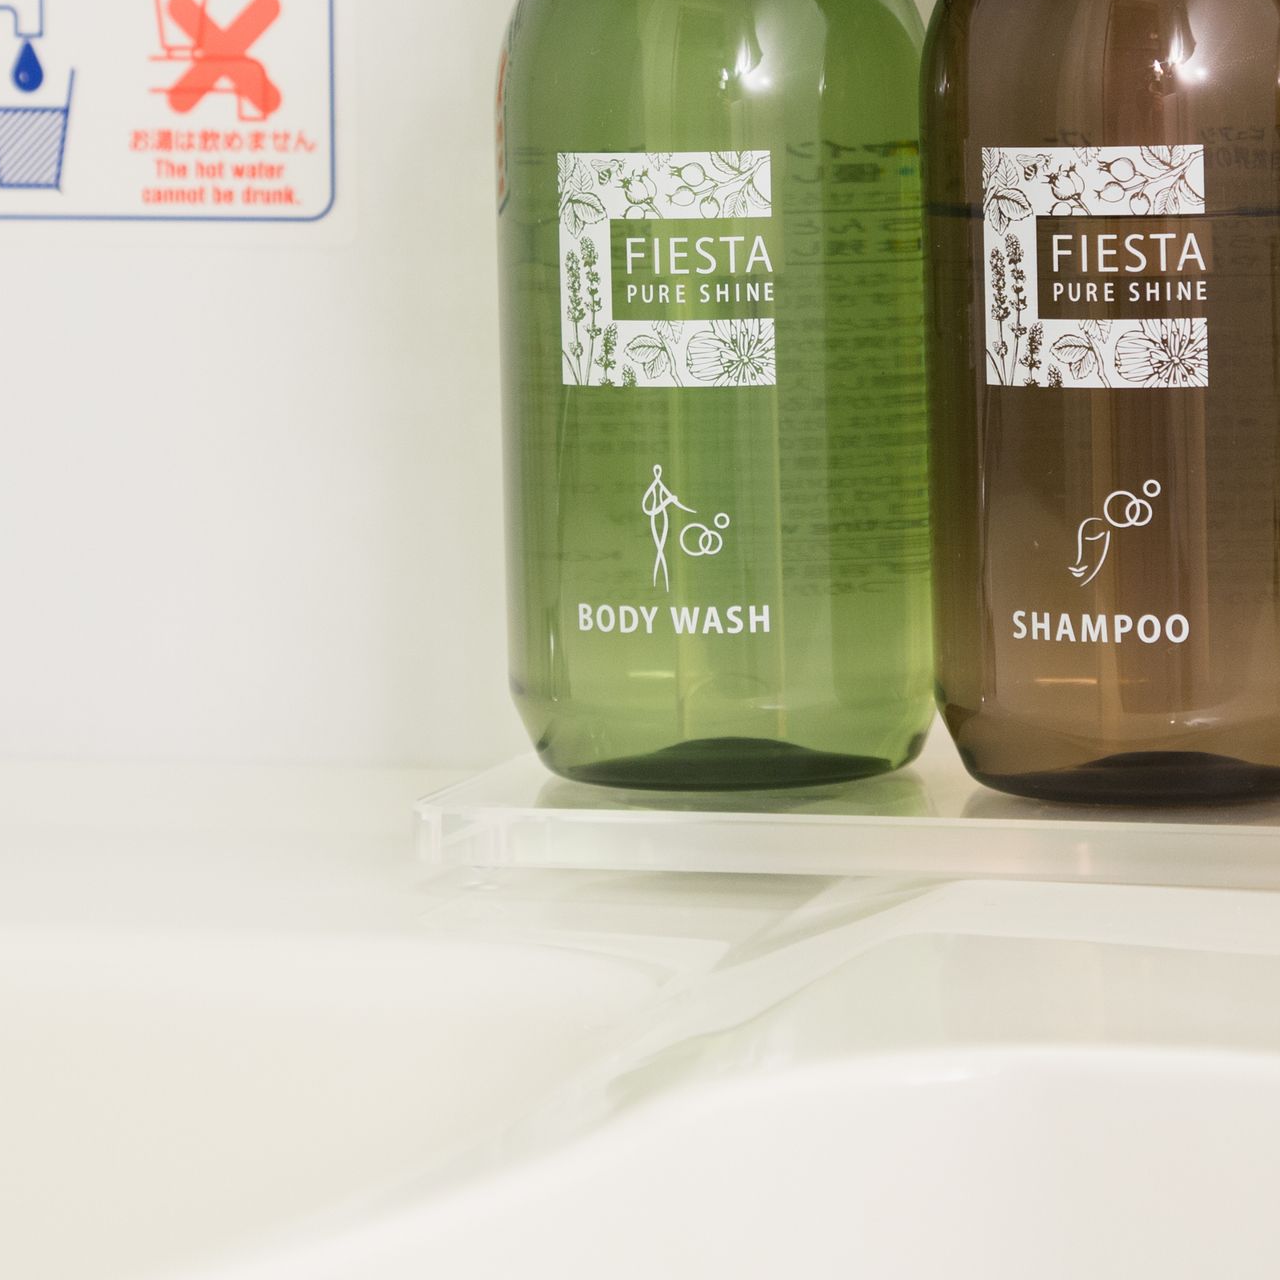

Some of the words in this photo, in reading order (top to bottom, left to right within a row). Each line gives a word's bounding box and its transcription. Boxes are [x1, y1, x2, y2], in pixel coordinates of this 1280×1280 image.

[155, 159, 188, 179] The
[195, 160, 224, 179] hot
[233, 160, 285, 179] water
[142, 186, 206, 205] cannot
[213, 185, 234, 204] be
[242, 185, 301, 205] drunk.
[627, 236, 773, 274] FIESTA
[1053, 233, 1206, 272] FIESTA
[628, 284, 686, 303] PURE
[700, 283, 774, 303] SHINE
[1054, 283, 1114, 302] PURE
[1129, 281, 1207, 301] SHINE
[579, 604, 658, 633] BODY
[670, 605, 769, 634] WASH
[1013, 611, 1189, 643] SHAMPOO
